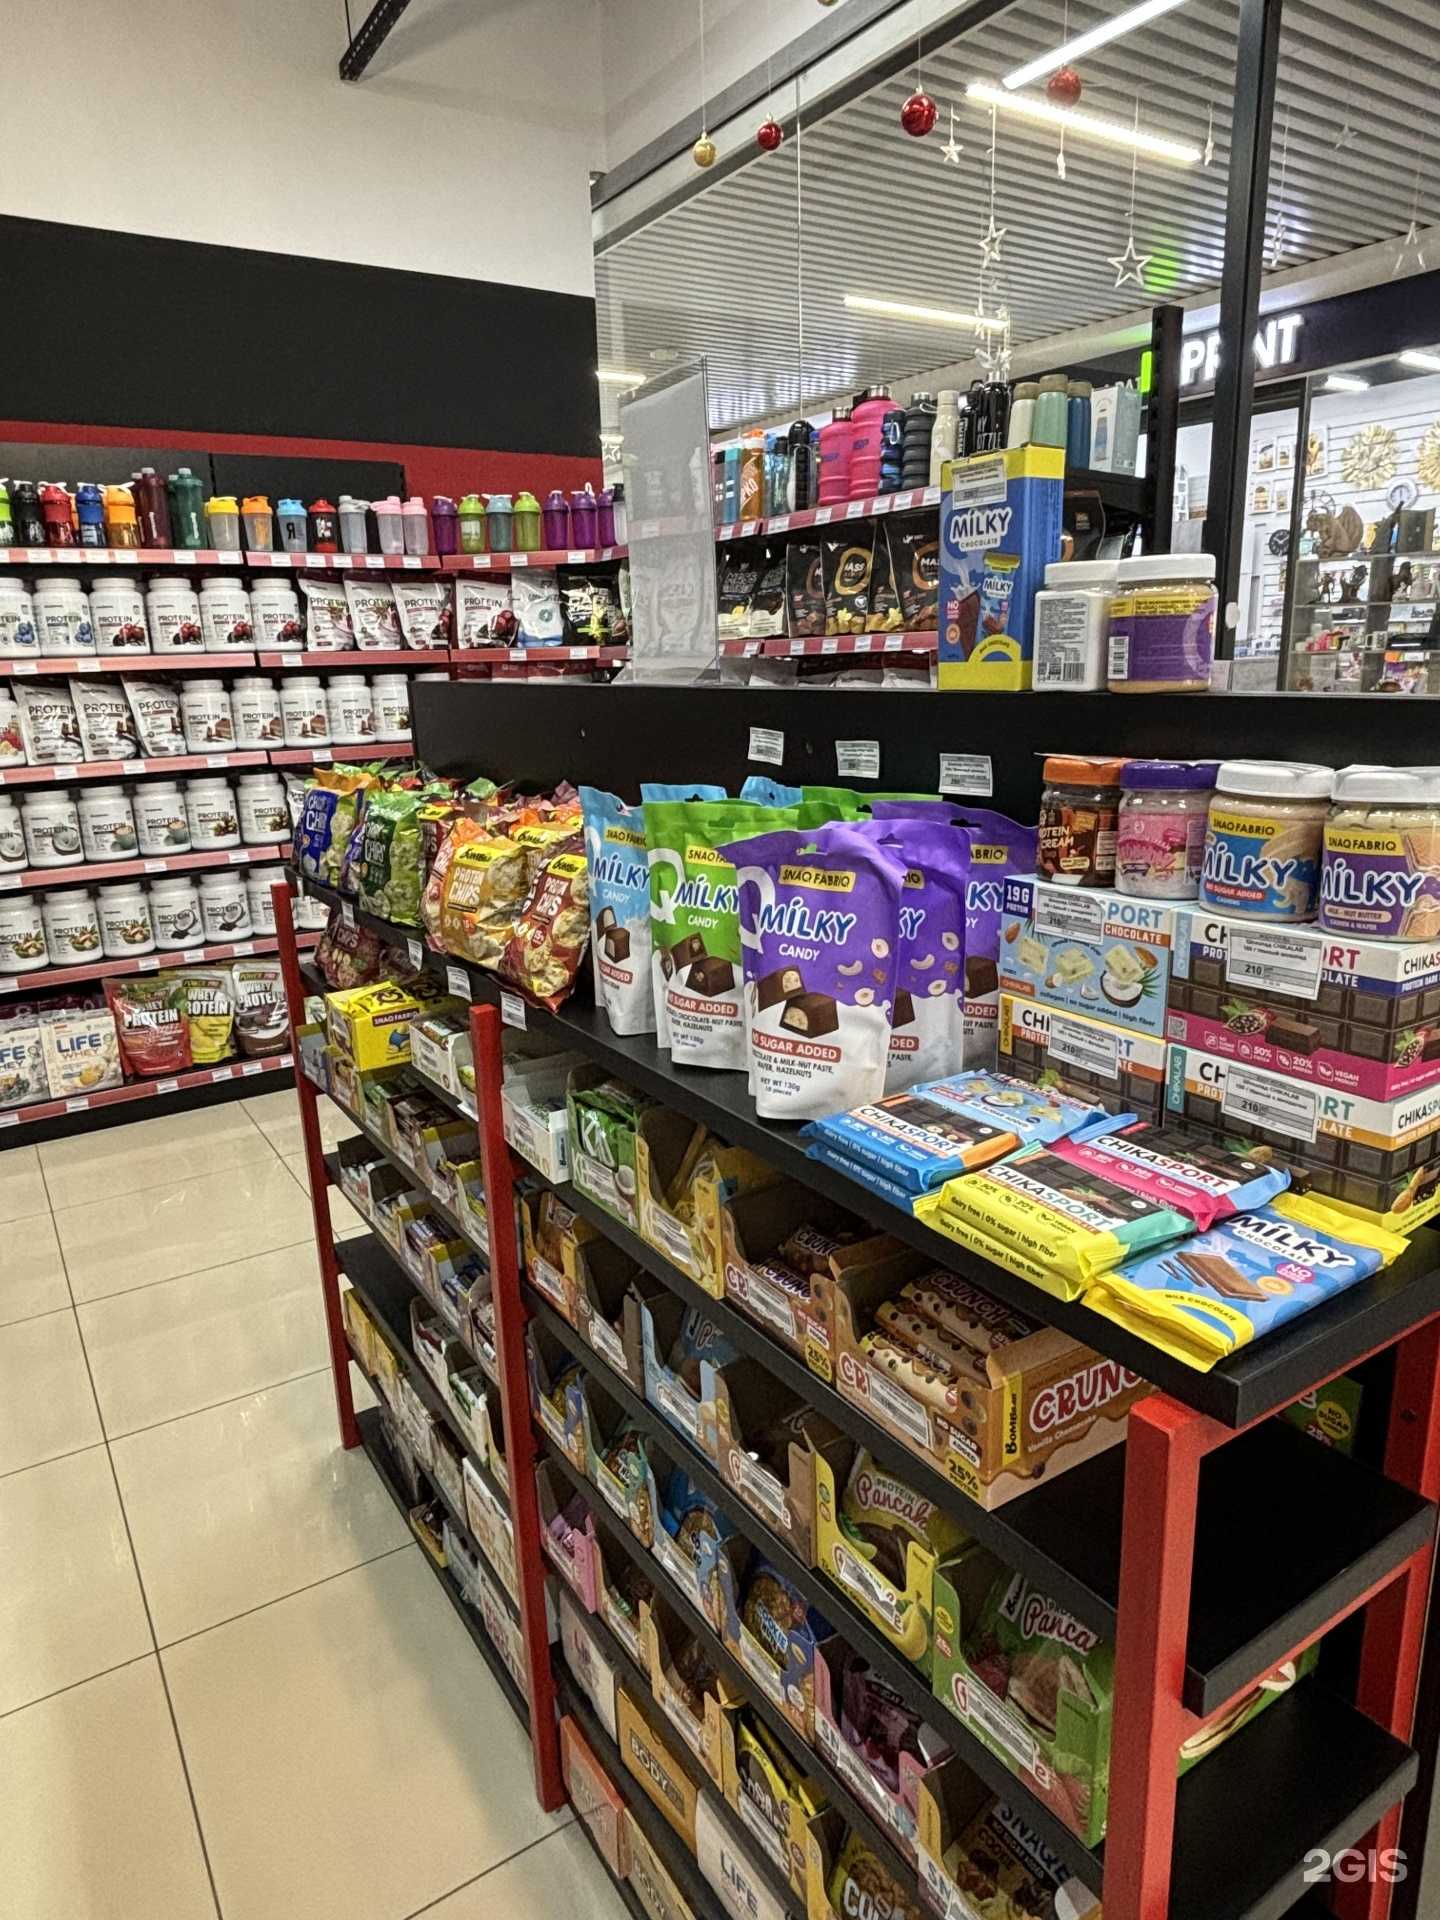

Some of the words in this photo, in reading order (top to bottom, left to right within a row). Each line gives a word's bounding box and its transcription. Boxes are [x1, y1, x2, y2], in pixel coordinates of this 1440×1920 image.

[0, 615, 21, 623] TEIN
[46, 615, 82, 623] PROTEIN
[98, 615, 133, 623] PROTEIN
[158, 614, 191, 622] PROTEIN
[212, 613, 245, 621] PROTEIN
[242, 712, 274, 720] PROTEIN
[285, 710, 315, 718] PROTEIN
[782, 868, 812, 884] SNAQ
[687, 914, 719, 929] CANDY
[1103, 924, 1162, 945] CHOCOLATE
[779, 943, 820, 961] CANDY
[1244, 964, 1262, 976] 210
[187, 990, 214, 1000] WHEY
[699, 1002, 735, 1015] ADDED
[124, 1008, 179, 1028] PROTEIN
[56, 1033, 102, 1053] LIFE
[760, 1036, 793, 1052] SUGAR
[797, 1045, 837, 1060] ADDED
[1061, 1043, 1075, 1053] 210
[0, 1045, 26, 1061] FE
[61, 1048, 101, 1060] WHEY
[1253, 1045, 1272, 1058] 50%
[1293, 1056, 1313, 1069] 20%
[1334, 1069, 1360, 1082] VEGAN
[1241, 1100, 1259, 1113] 210
[860, 1106, 961, 1152] CHIKASPORT
[1098, 1136, 1230, 1188] CHIKASPORT
[986, 1166, 1113, 1228] CHIKASPORT
[969, 1205, 981, 1218] free
[985, 1215, 997, 1226] 0%
[997, 1221, 1017, 1239] sugar
[1021, 1232, 1038, 1248] high
[1038, 1242, 1057, 1258] fiber
[973, 1236, 984, 1247] 0%
[984, 1243, 1004, 1260] sugar
[1009, 1255, 1025, 1270] high
[1237, 1230, 1311, 1264] CHOCOLATE
[1286, 1263, 1312, 1278] NO
[1188, 1296, 1238, 1321] CHOCOLATE
[1319, 1410, 1350, 1431] SUGAR
[1328, 1407, 1342, 1420] NO
[935, 1417, 950, 1430] NO
[950, 1425, 978, 1452] SUGAR
[947, 1458, 980, 1492] 25%
[630, 1735, 671, 1791] BODY
